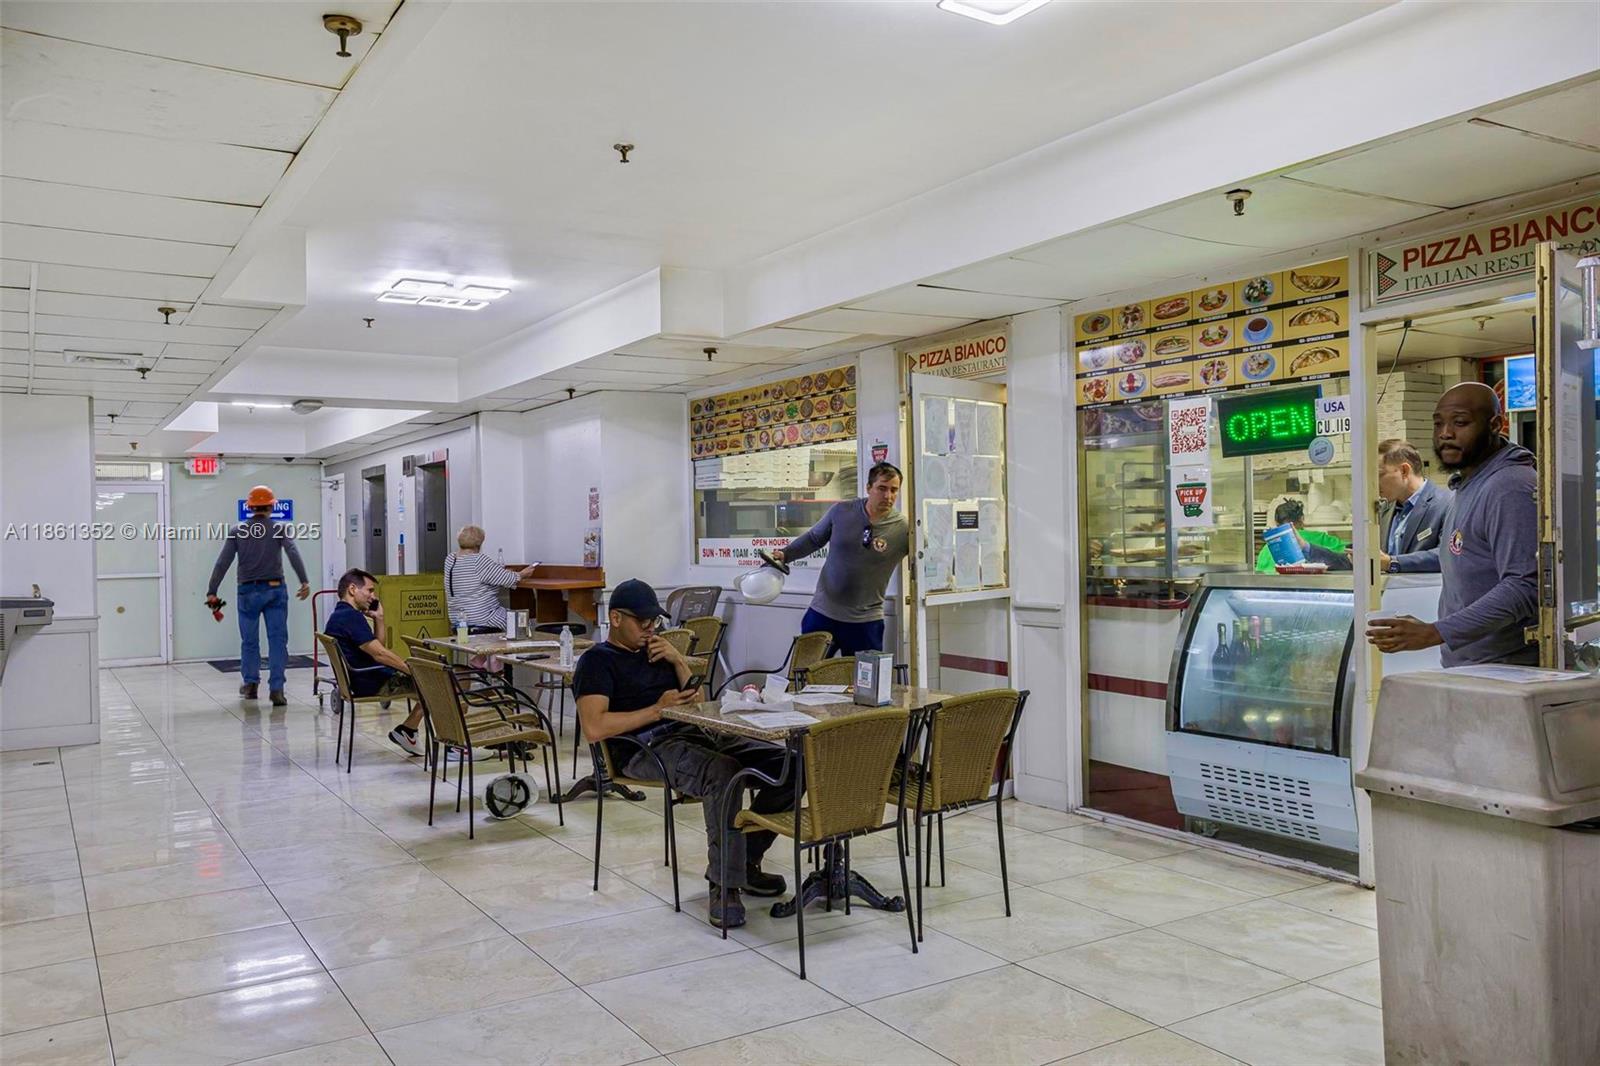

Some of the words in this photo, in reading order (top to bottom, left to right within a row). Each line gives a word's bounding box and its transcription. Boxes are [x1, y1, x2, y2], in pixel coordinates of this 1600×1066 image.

[1403, 233, 1483, 272] PIZZA
[1490, 205, 1600, 253] BIANC
[1405, 264, 1477, 291] ITALIAN
[919, 349, 952, 369] PIZZA
[955, 336, 1006, 362] BIANCO
[953, 356, 1007, 376] RESTAURANT
[1324, 401, 1345, 413] USA
[1229, 405, 1312, 441] OPEN
[195, 459, 216, 474] EXIT
[752, 538, 767, 547] OPEN
[702, 548, 715, 558] SUN
[719, 548, 731, 558] THR
[732, 548, 749, 558] 10AM
